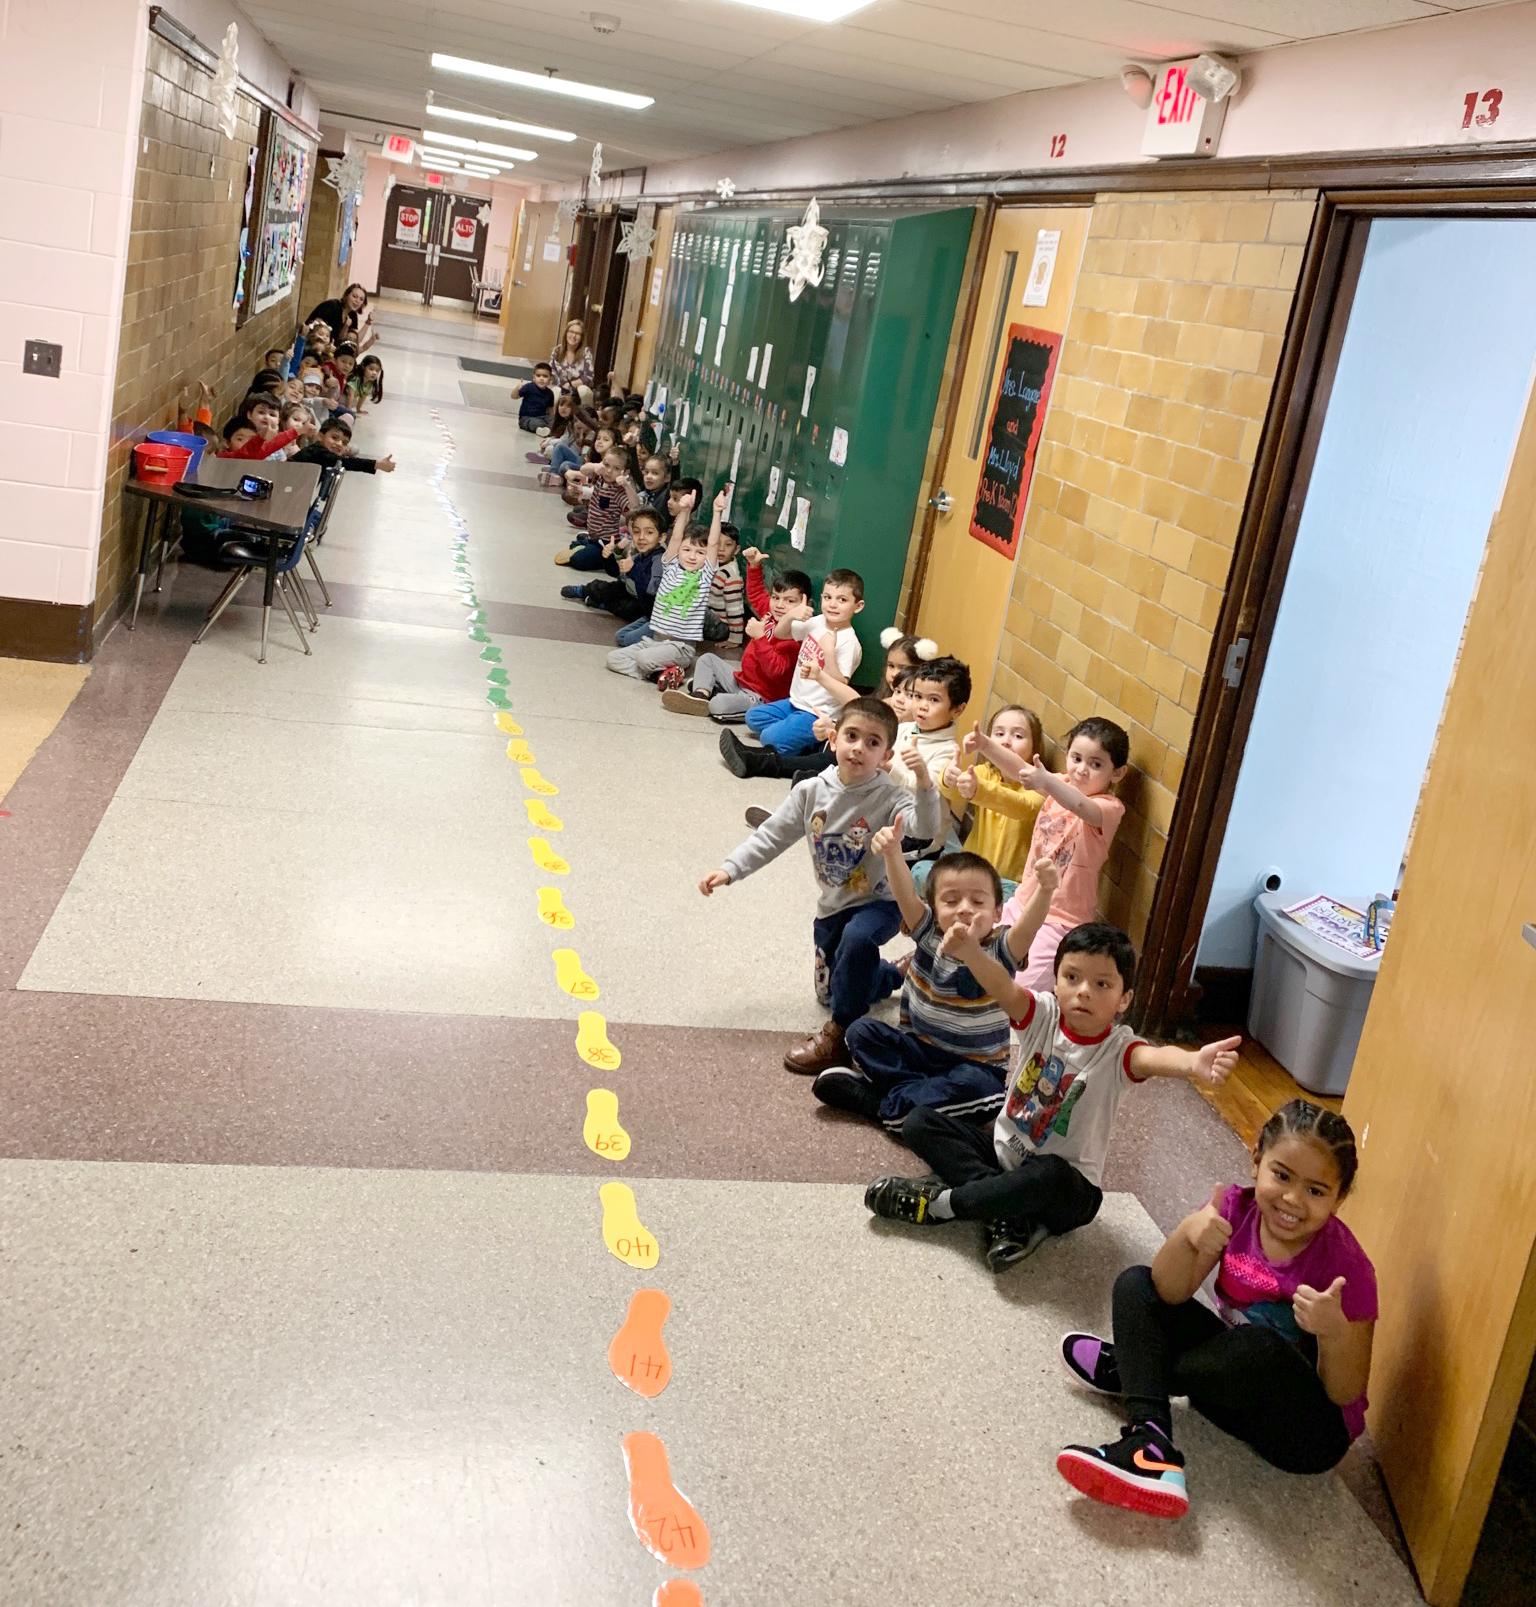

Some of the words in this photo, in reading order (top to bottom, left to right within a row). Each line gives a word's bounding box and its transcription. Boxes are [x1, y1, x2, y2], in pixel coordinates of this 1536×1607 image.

[1461, 88, 1503, 128] 13
[1050, 134, 1067, 158] 12
[400, 213, 419, 223] STOP
[455, 223, 474, 233] ALTO
[570, 981, 597, 995] 37
[587, 1047, 616, 1064] 38
[595, 1133, 623, 1151] 39
[616, 1236, 650, 1257] 40
[629, 1353, 663, 1379] 41
[647, 1514, 697, 1553] 42
